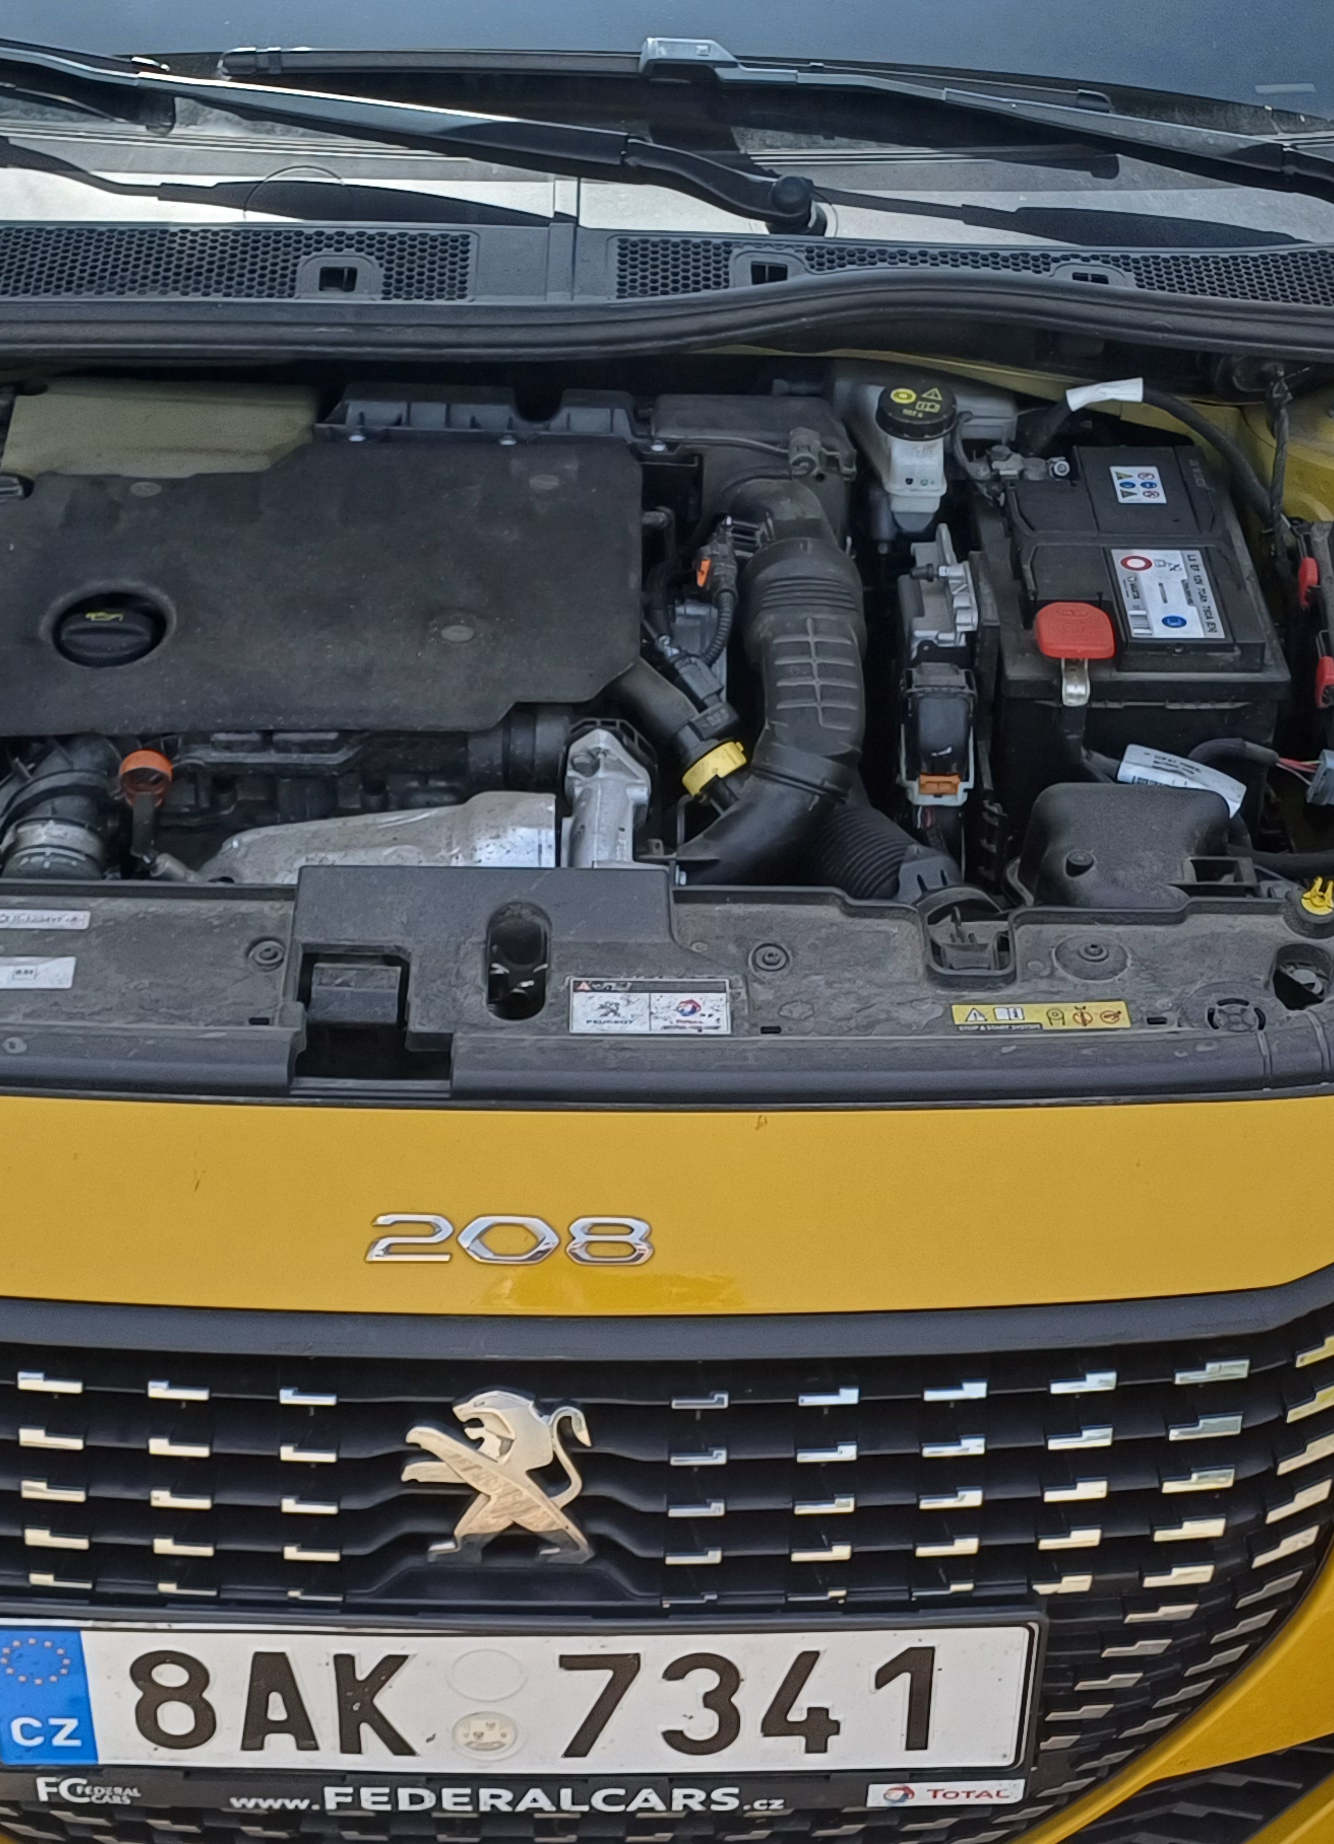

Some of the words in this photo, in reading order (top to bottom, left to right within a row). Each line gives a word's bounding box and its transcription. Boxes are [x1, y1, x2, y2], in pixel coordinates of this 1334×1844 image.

[365, 1213, 655, 1265] 208
[129, 1650, 418, 1757] 8AK
[559, 1646, 936, 1758] 7341
[10, 1716, 83, 1747] CZ
[35, 1776, 91, 1803] FC
[76, 1786, 142, 1798] FEDERAL
[229, 1786, 786, 1812] www.FEDERALCARS.cz
[925, 1786, 1011, 1800] TOTAL
